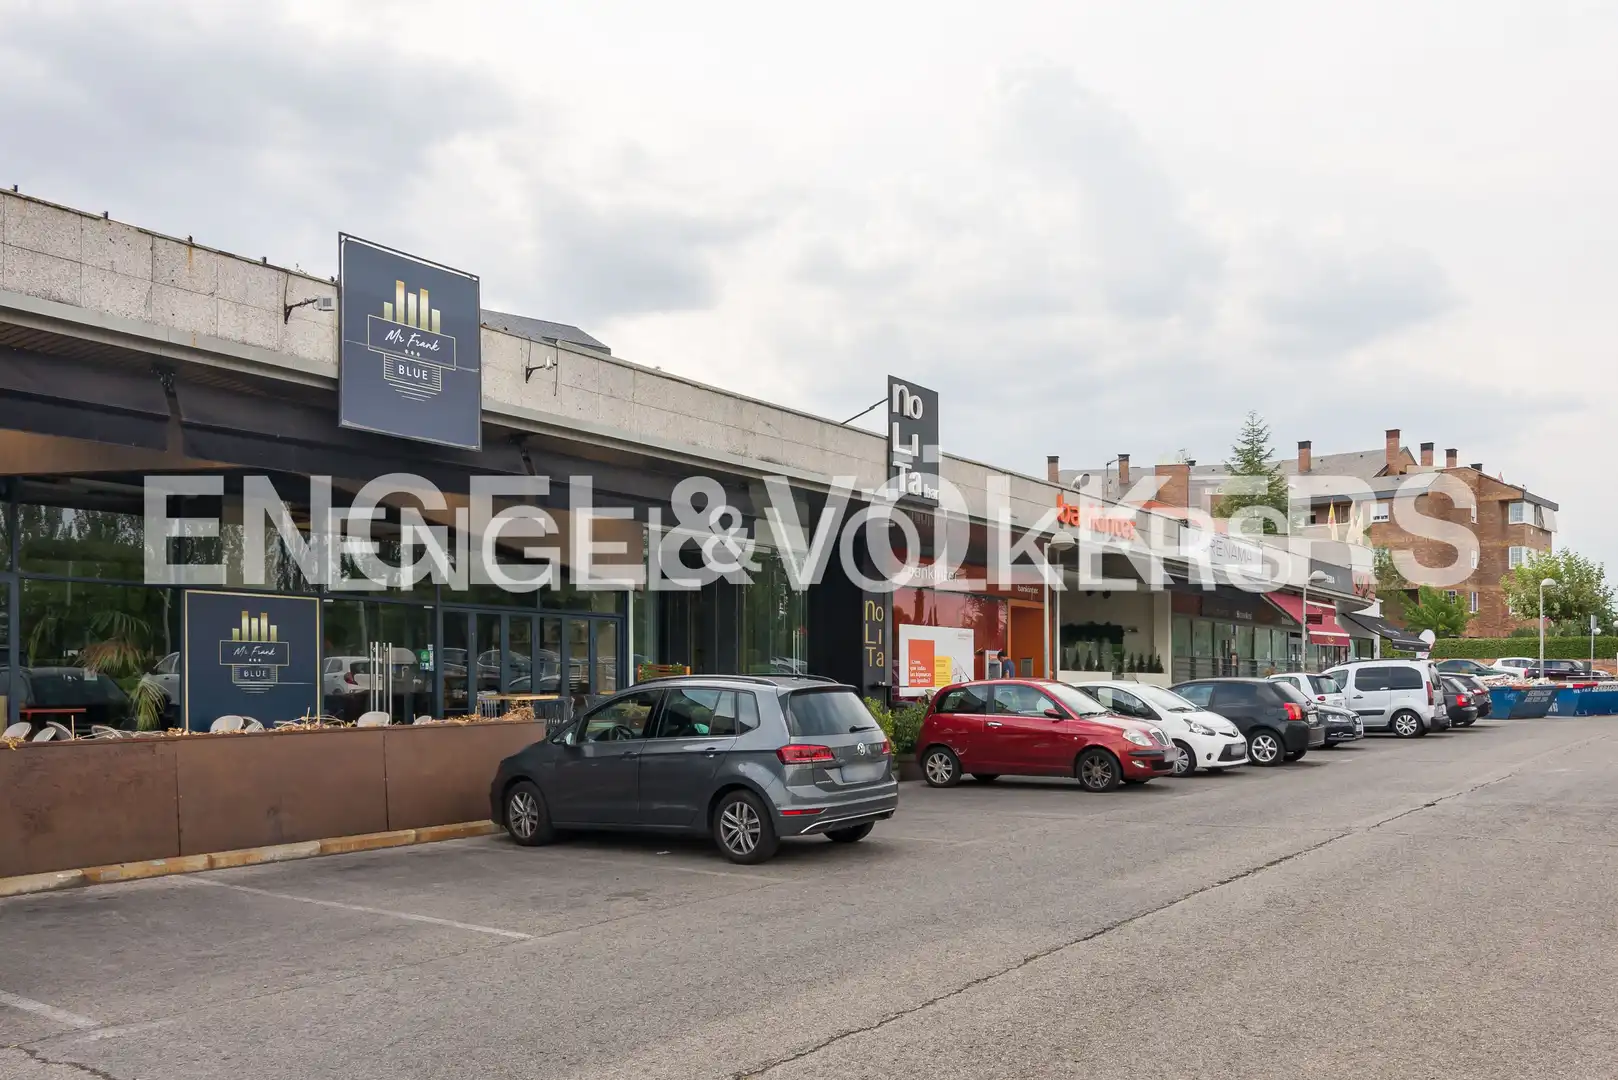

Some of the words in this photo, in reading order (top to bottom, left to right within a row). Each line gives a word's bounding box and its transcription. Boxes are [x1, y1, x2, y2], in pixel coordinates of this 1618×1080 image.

[385, 328, 405, 344] Mr
[407, 331, 441, 352] Frank
[398, 364, 428, 380] BLUE
[250, 645, 277, 657] Frank
[243, 669, 266, 677] BLUE
